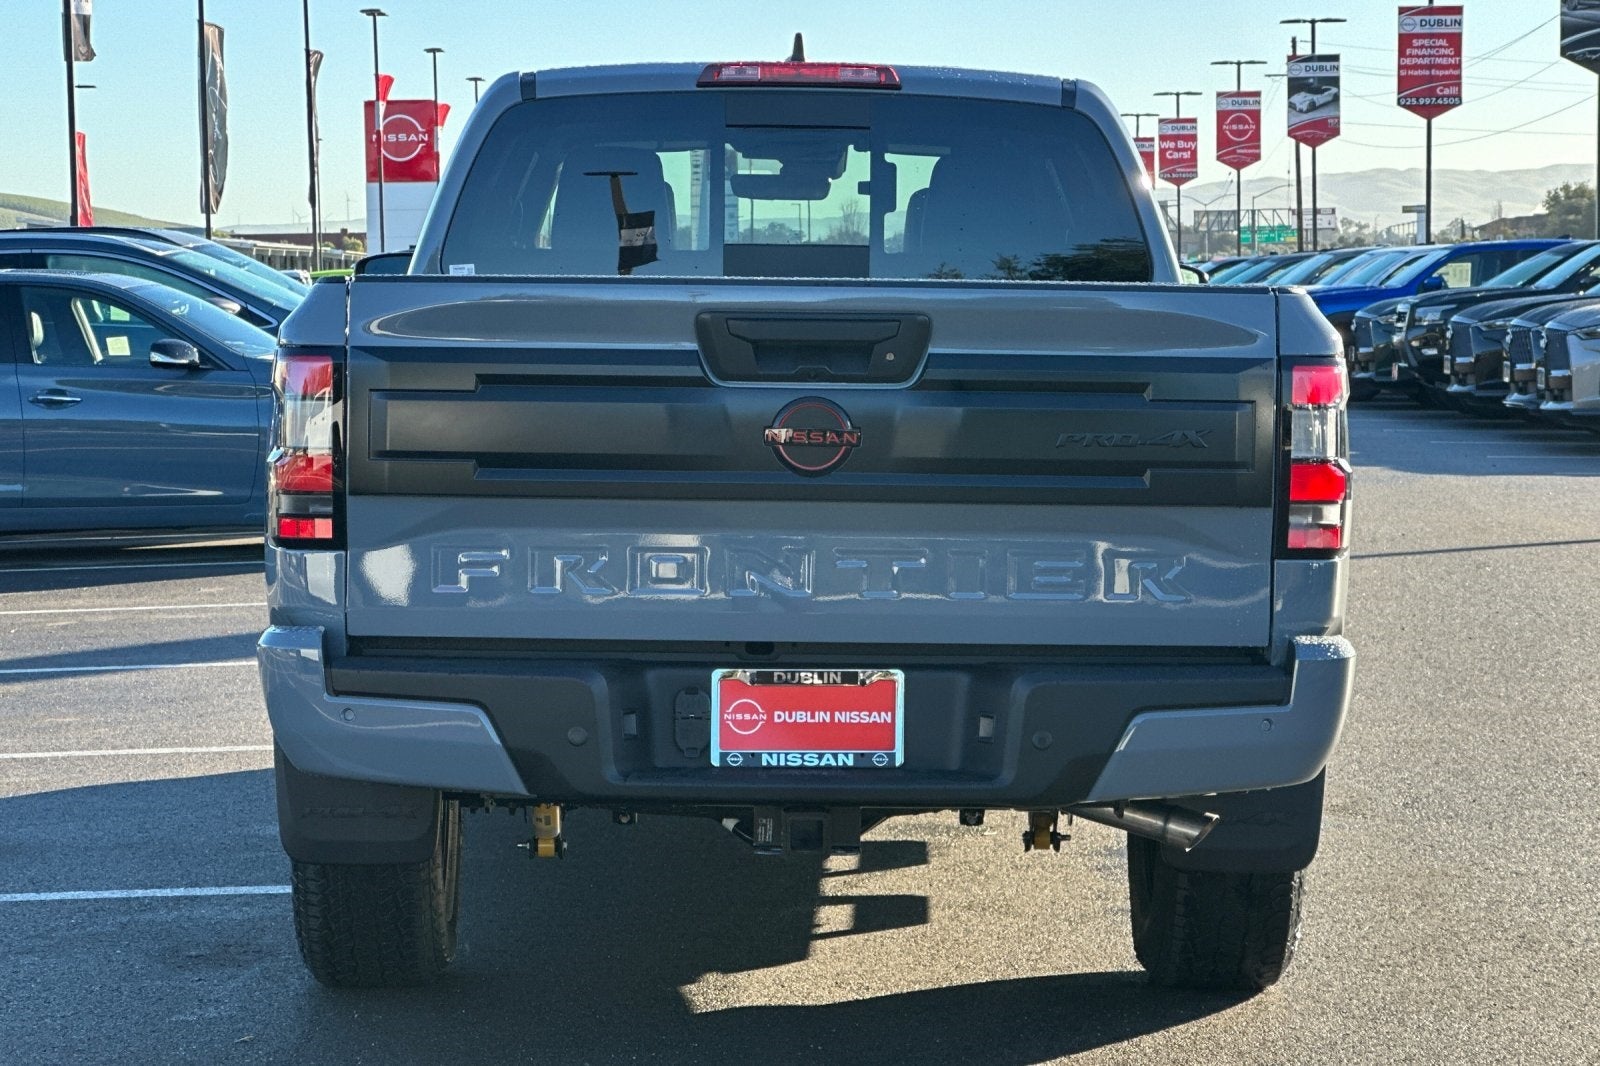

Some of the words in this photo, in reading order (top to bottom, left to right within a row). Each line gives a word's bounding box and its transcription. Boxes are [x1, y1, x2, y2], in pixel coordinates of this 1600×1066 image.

[1420, 19, 1461, 27] DUBLIN
[1400, 57, 1460, 65] DEPARTMENT
[1431, 69, 1460, 77] Español
[1436, 86, 1458, 95] Call!
[1399, 97, 1460, 105] 925.997.4505
[1160, 140, 1176, 149] We
[1177, 140, 1197, 151] Buy
[1165, 150, 1191, 159] Cars!
[765, 429, 859, 445] NISSAN
[431, 543, 1192, 602] FRONTIER
[773, 671, 842, 684] DUBLIN
[773, 711, 831, 723] DUBLIN
[834, 711, 892, 723] NISSAN
[761, 753, 854, 766] NISSAN
